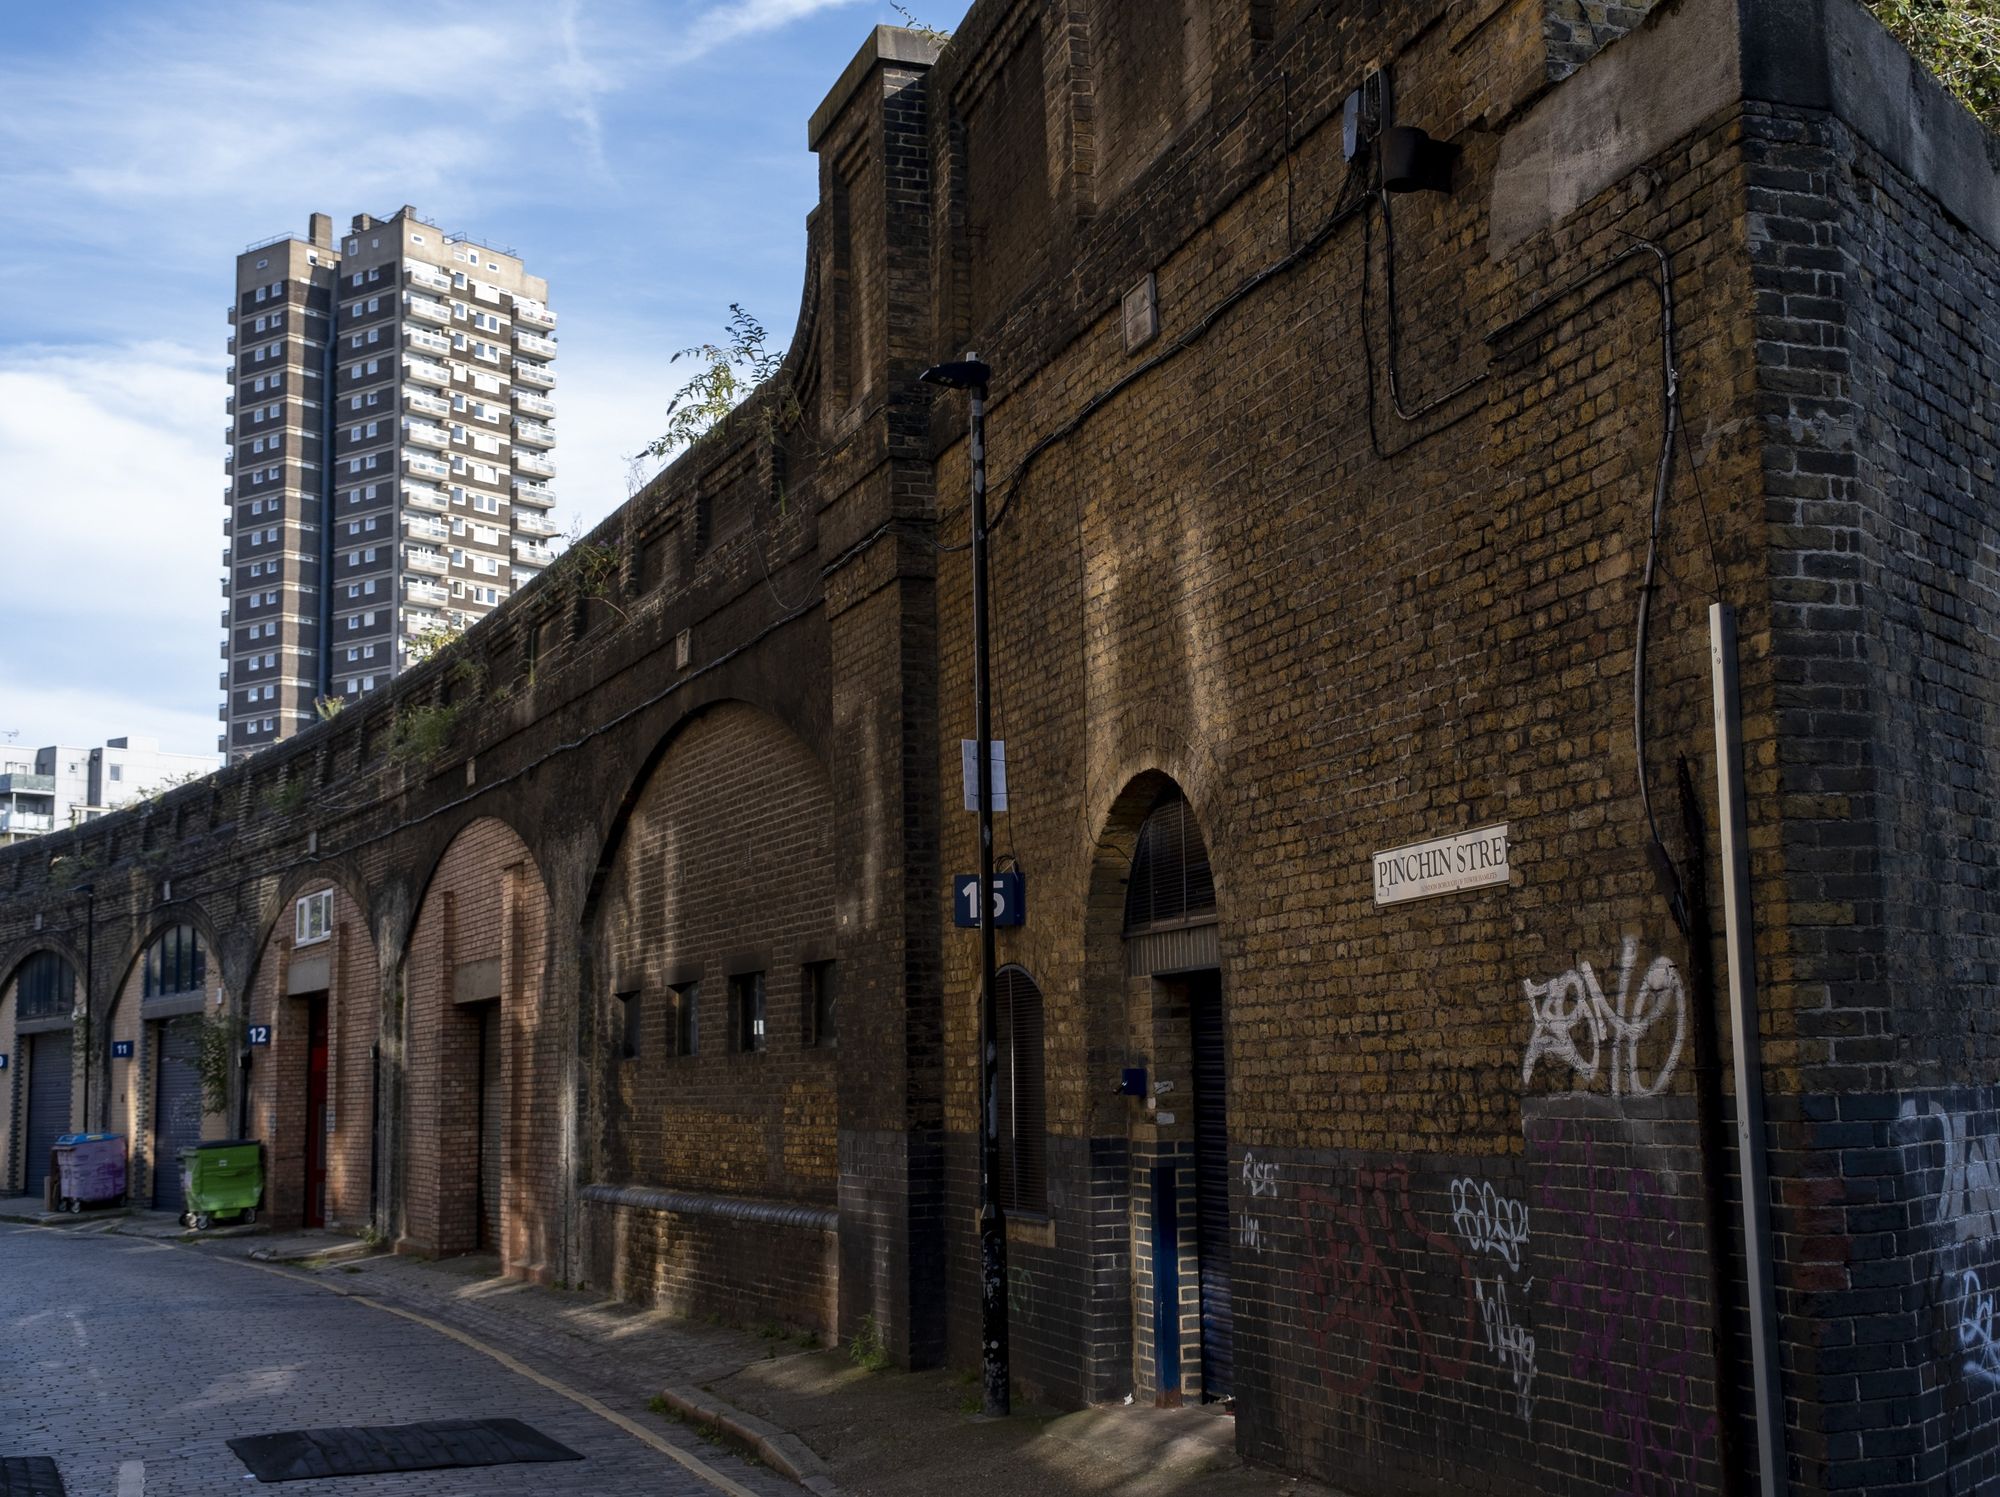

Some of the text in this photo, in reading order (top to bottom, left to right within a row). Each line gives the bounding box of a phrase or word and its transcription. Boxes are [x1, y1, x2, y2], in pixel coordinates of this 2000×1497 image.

[1378, 847, 1451, 888] PINCHIN
[249, 1026, 267, 1043] 12
[117, 1044, 128, 1055] 11
